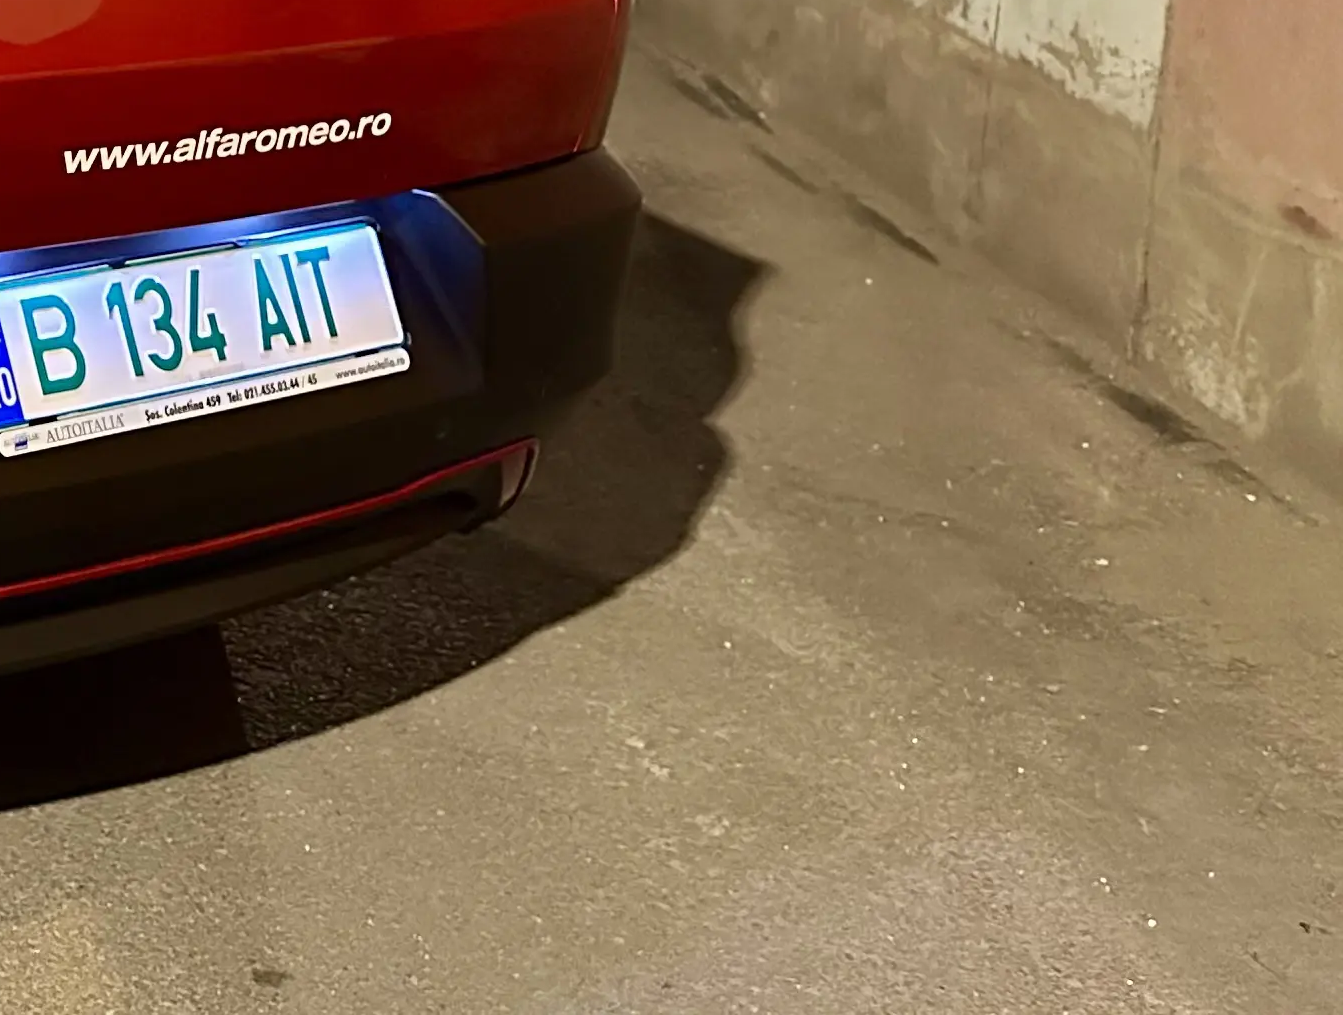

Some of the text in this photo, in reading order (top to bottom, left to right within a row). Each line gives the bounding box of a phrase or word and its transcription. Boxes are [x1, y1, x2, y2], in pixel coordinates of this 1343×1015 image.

[63, 111, 393, 174] www.alfaromeo.ro
[19, 245, 340, 396] B 134 AIT
[335, 357, 406, 380] www.autoitalia.ro
[164, 398, 205, 417] Colentina
[206, 394, 222, 407] 459
[227, 388, 243, 404] Tel:
[307, 372, 318, 386] 45
[46, 414, 125, 444] AUTOITALIA
